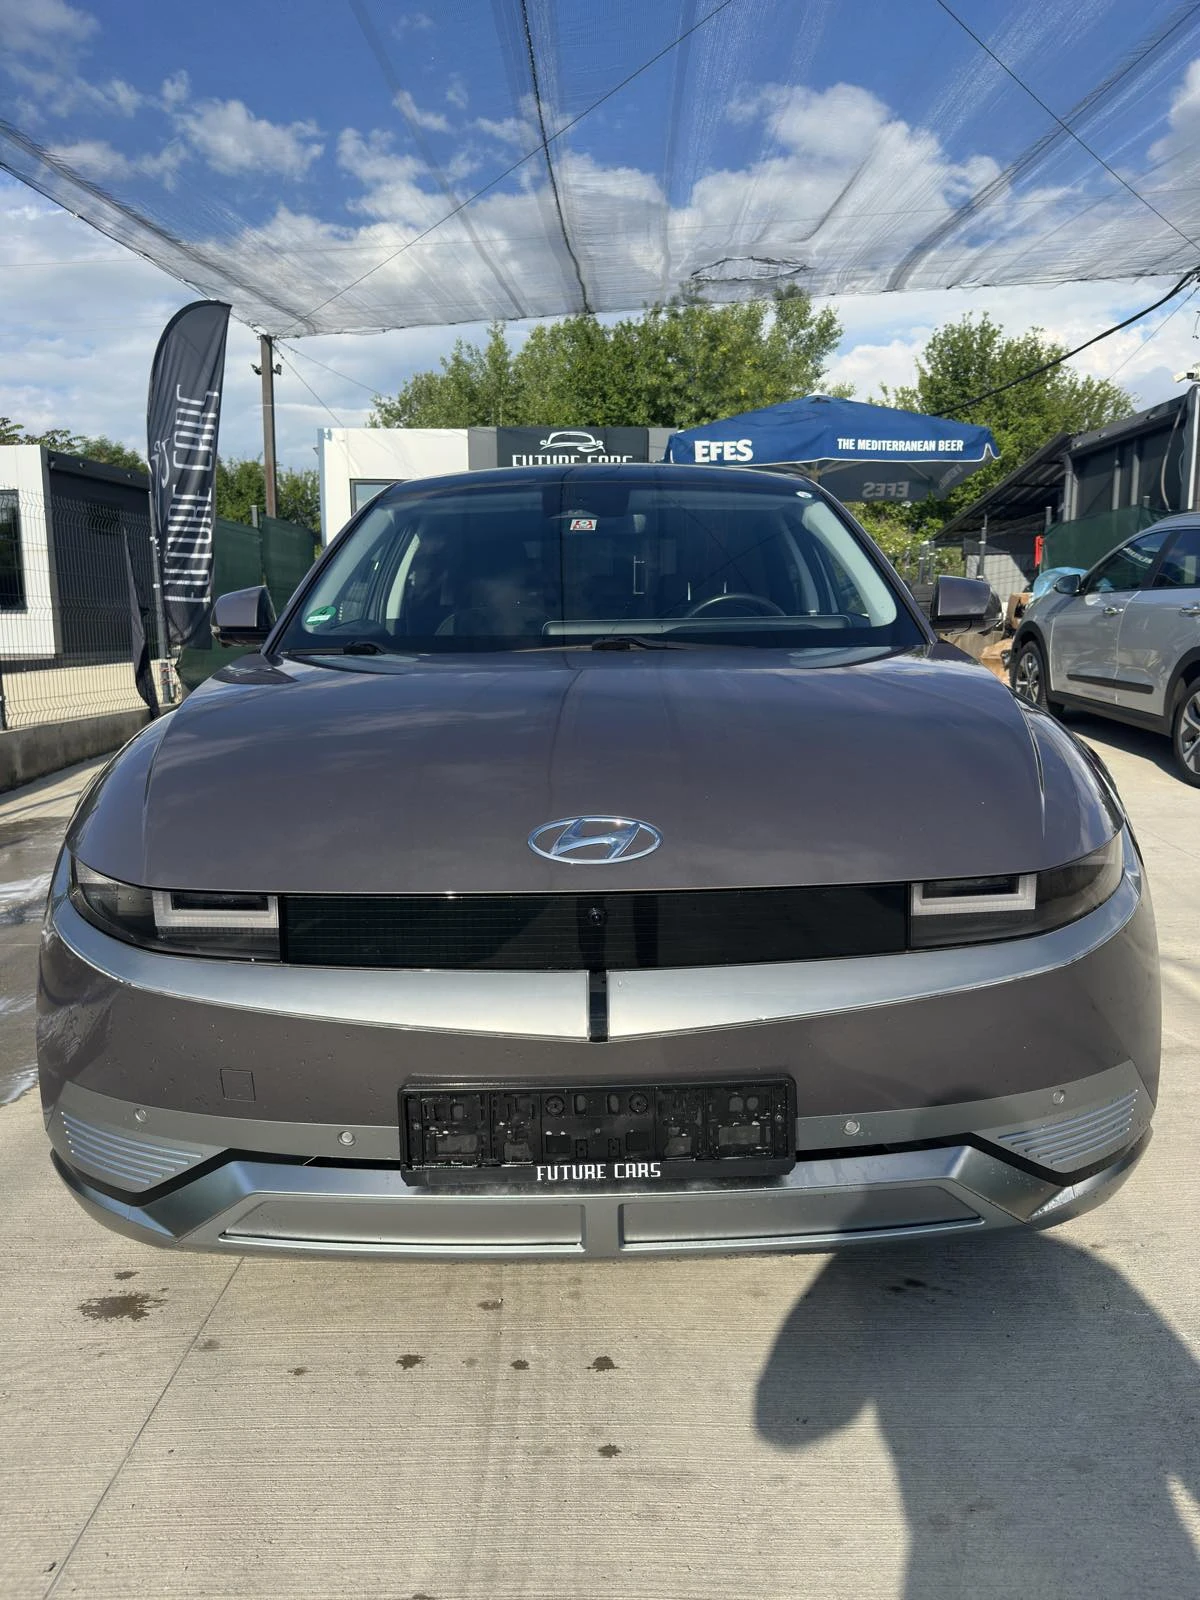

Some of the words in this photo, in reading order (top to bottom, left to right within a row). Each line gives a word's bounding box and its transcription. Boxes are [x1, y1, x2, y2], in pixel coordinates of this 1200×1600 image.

[173, 384, 220, 471] CARS
[694, 439, 754, 463] EFES
[837, 438, 855, 450] THE
[858, 439, 936, 452] MEDITERRANEAN
[938, 440, 964, 452] BEER
[536, 1164, 607, 1181] FUTURE
[614, 1162, 661, 1179] CARS
